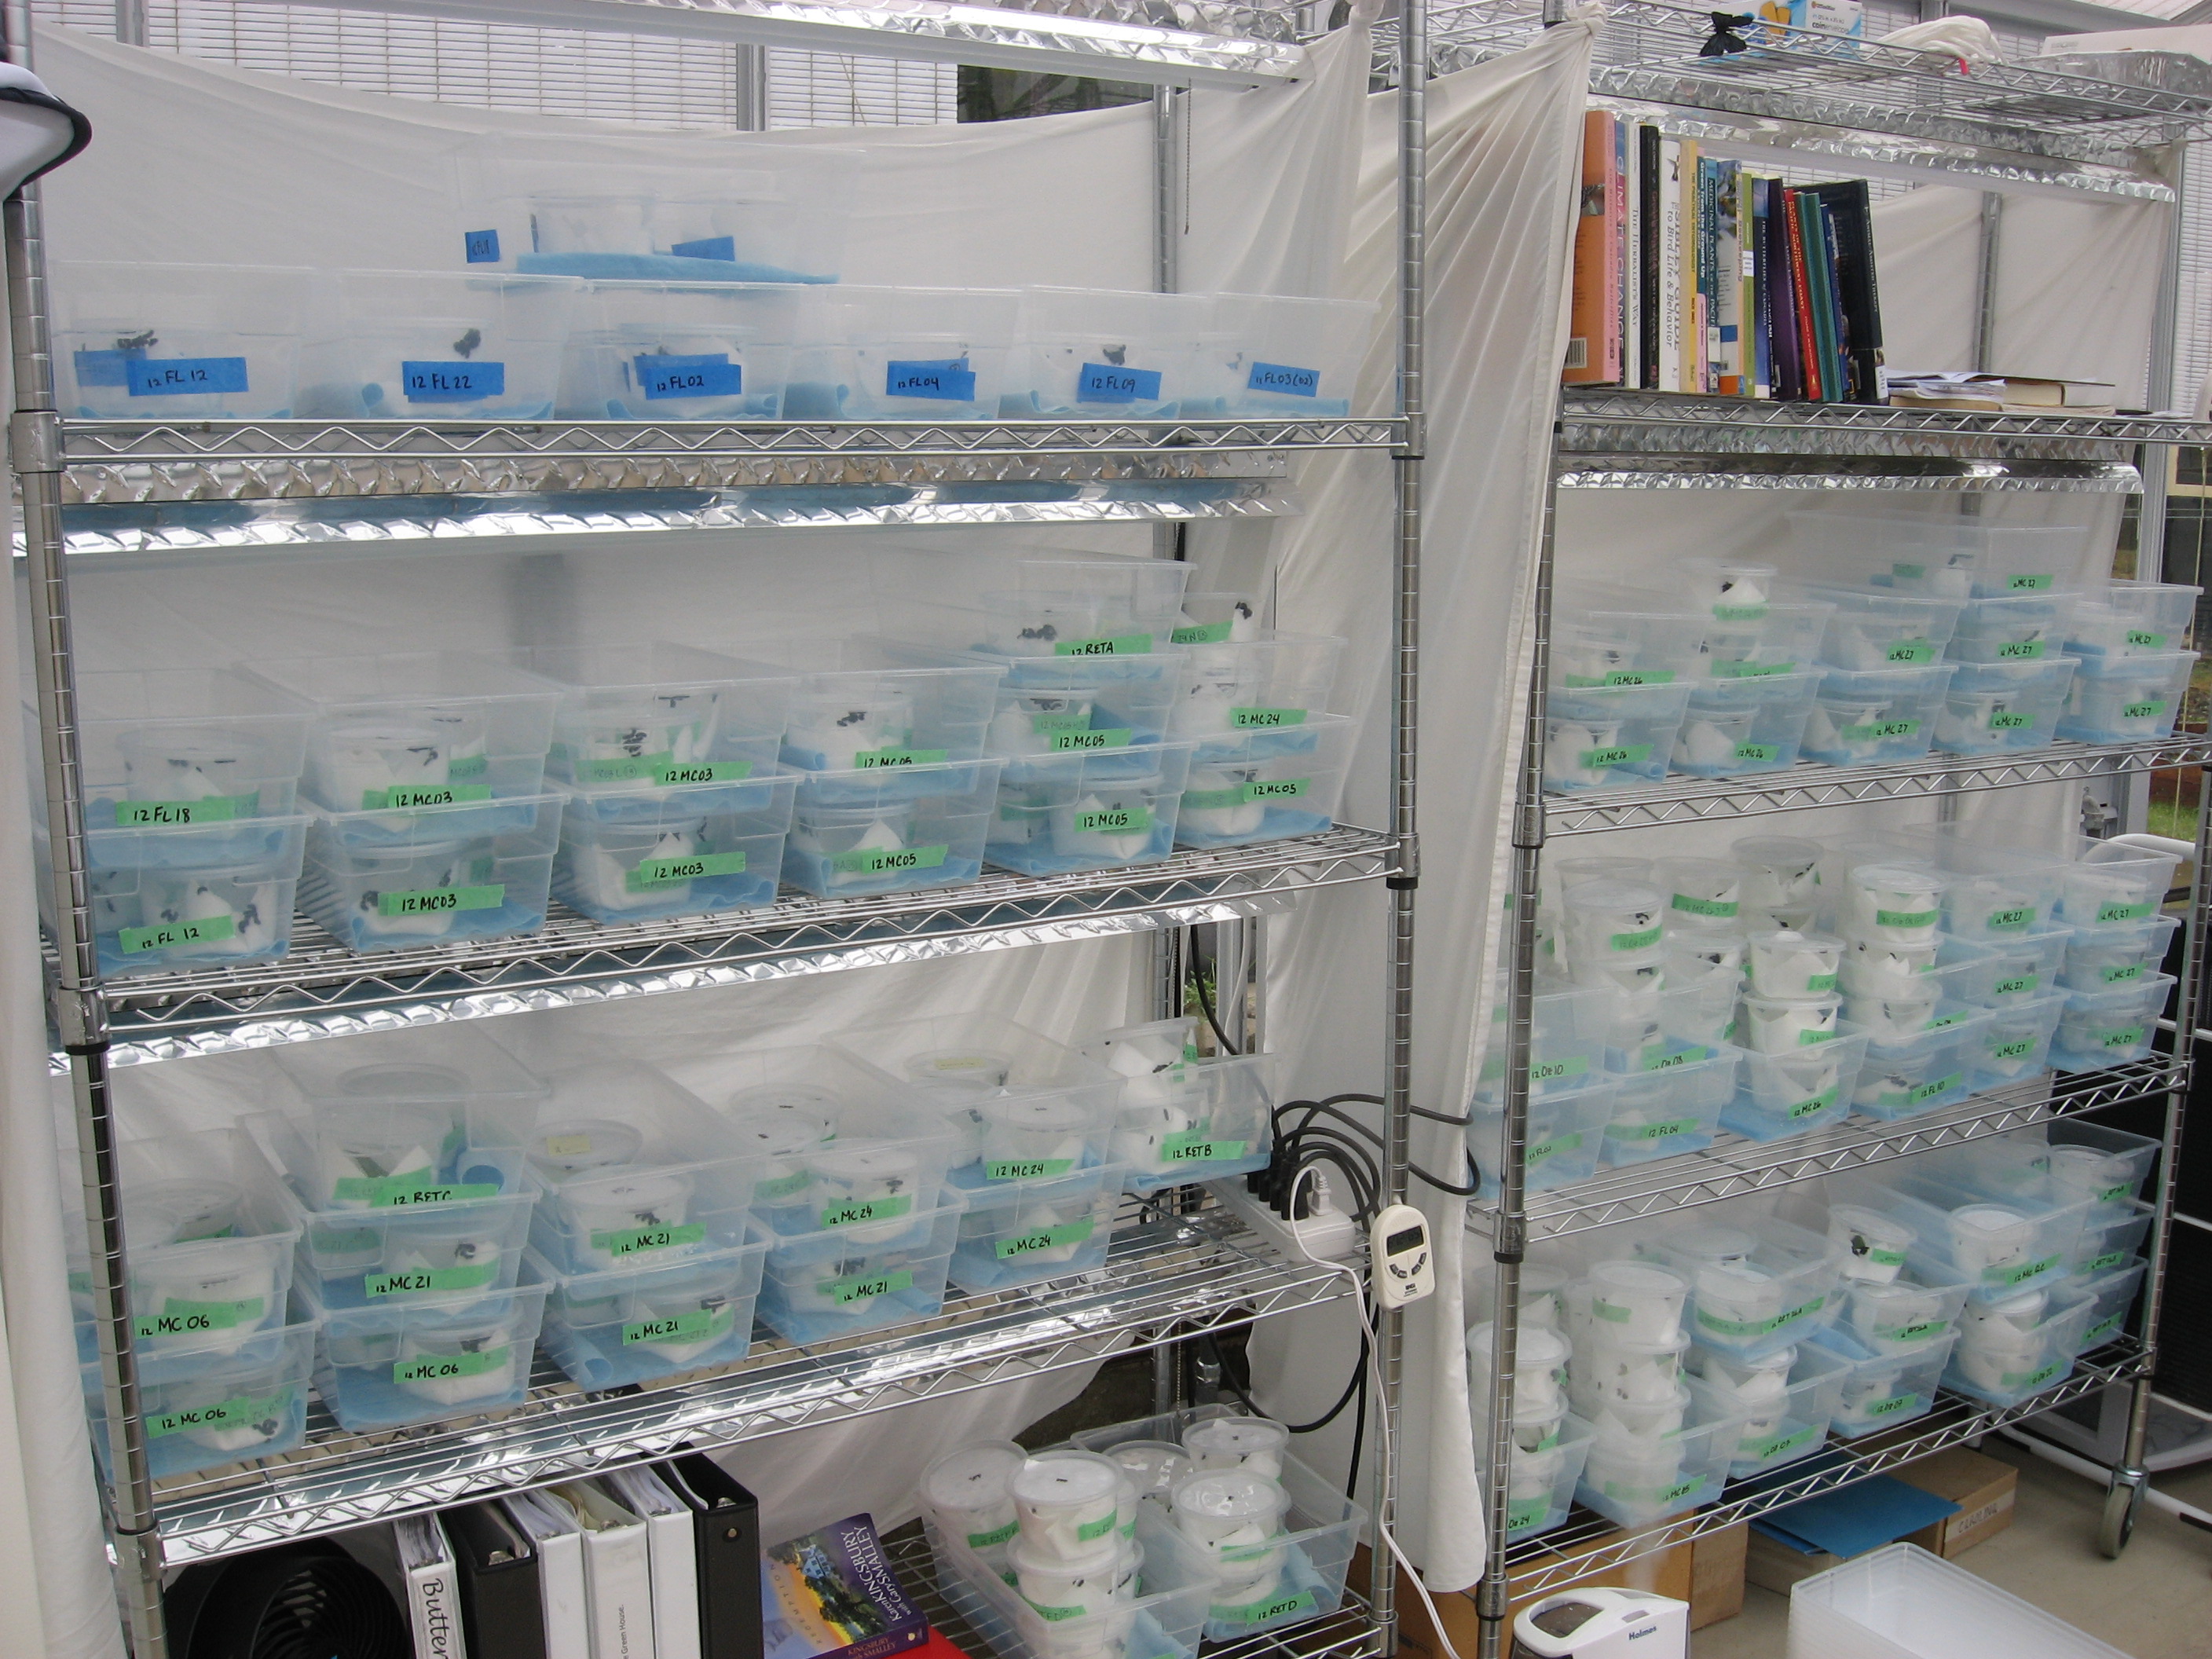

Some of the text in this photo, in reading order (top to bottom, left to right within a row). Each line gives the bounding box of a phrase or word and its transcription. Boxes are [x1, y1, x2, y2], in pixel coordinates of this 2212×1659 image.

[1666, 211, 1675, 222] to
[1666, 226, 1676, 251] Bird
[1666, 255, 1676, 277] Life
[1699, 266, 1706, 278] Up
[1617, 257, 1625, 350] CHANGE
[1666, 293, 1675, 348] Behavior
[412, 375, 426, 388] 12
[1238, 714, 1247, 724] 12
[1059, 738, 1070, 748] 12
[665, 771, 677, 781] 12
[1254, 786, 1265, 795] 12
[396, 794, 408, 807] 12
[134, 810, 150, 822] 12
[1083, 816, 1094, 828] 12
[872, 857, 884, 870] 12
[654, 866, 668, 877] 12
[401, 899, 416, 912] 12
[1172, 1148, 1182, 1159] 12
[1628, 1625, 1657, 1641] Holmes
